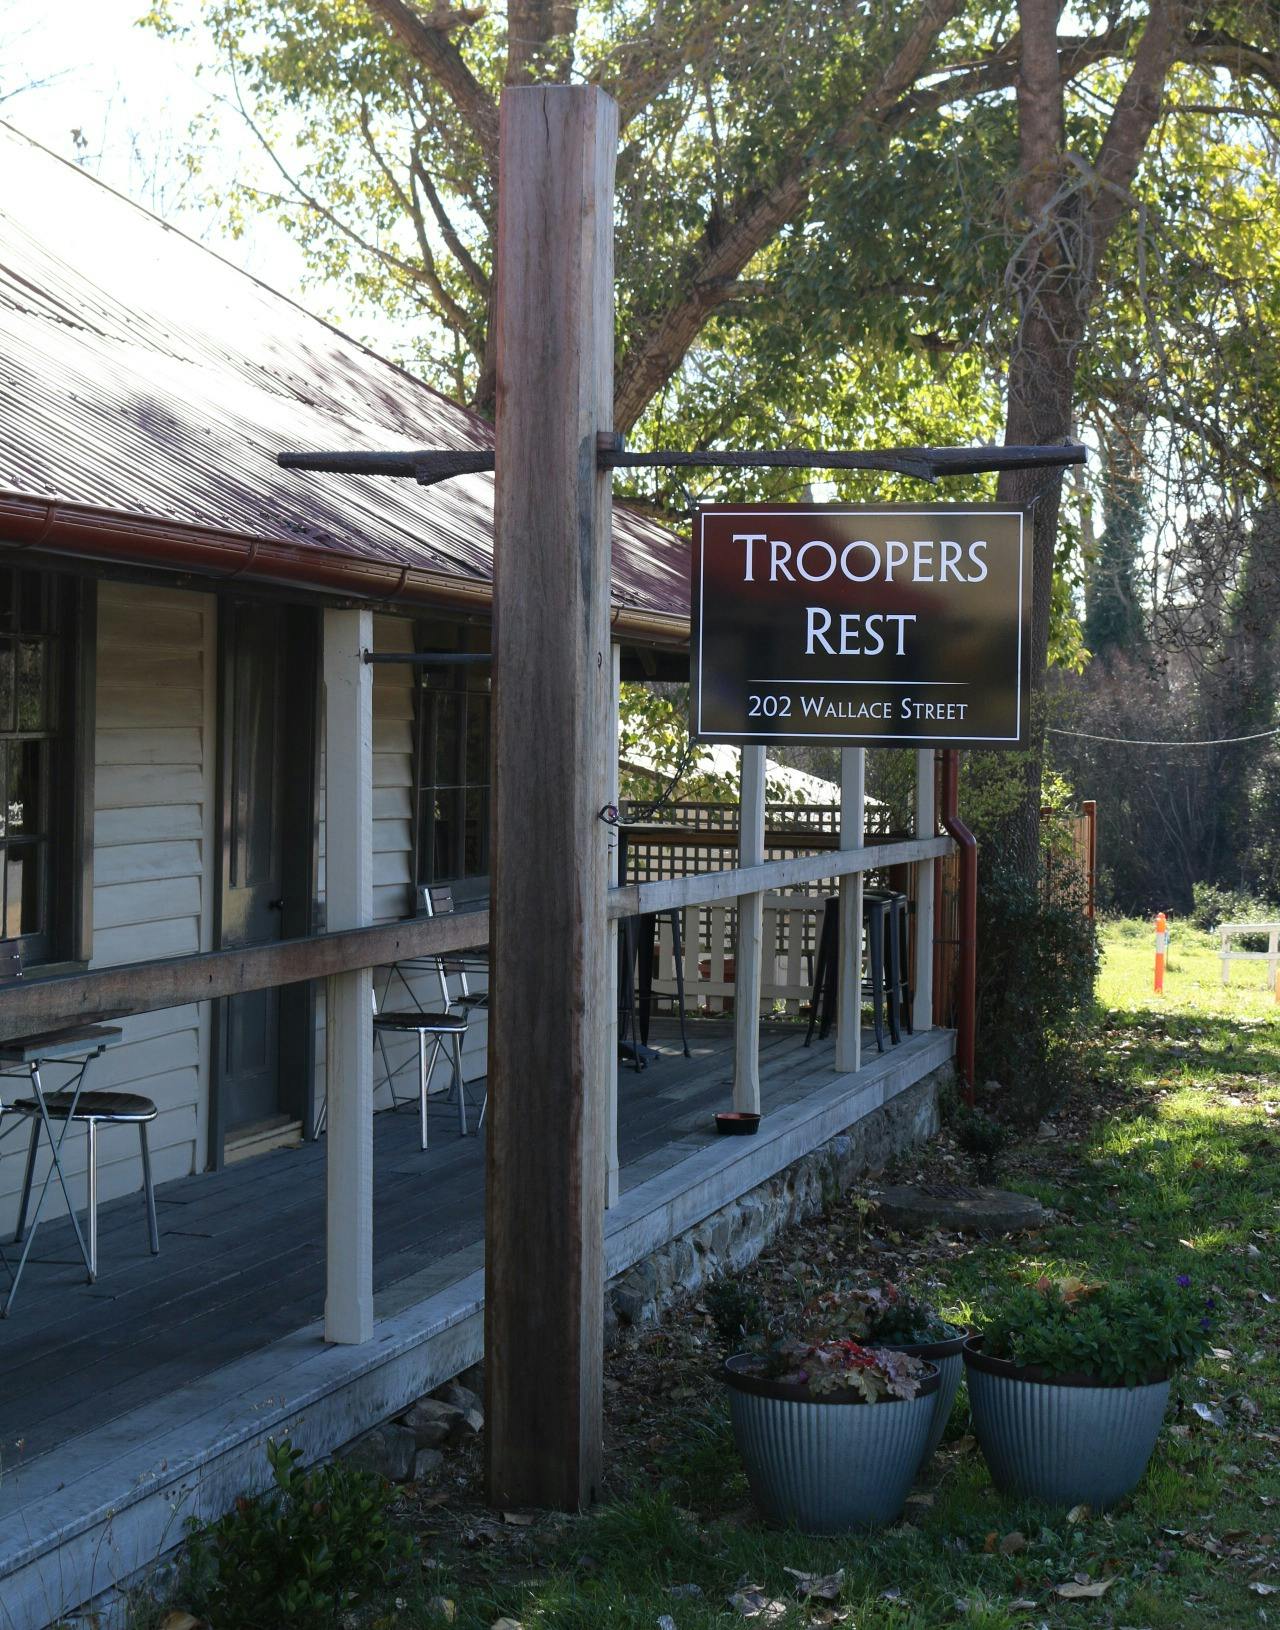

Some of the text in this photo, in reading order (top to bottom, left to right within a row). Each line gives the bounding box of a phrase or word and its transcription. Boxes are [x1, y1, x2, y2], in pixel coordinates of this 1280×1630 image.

[732, 534, 988, 583] TROOPERS
[804, 607, 917, 656] REST
[748, 695, 969, 720] 202 WALLACE STREET
